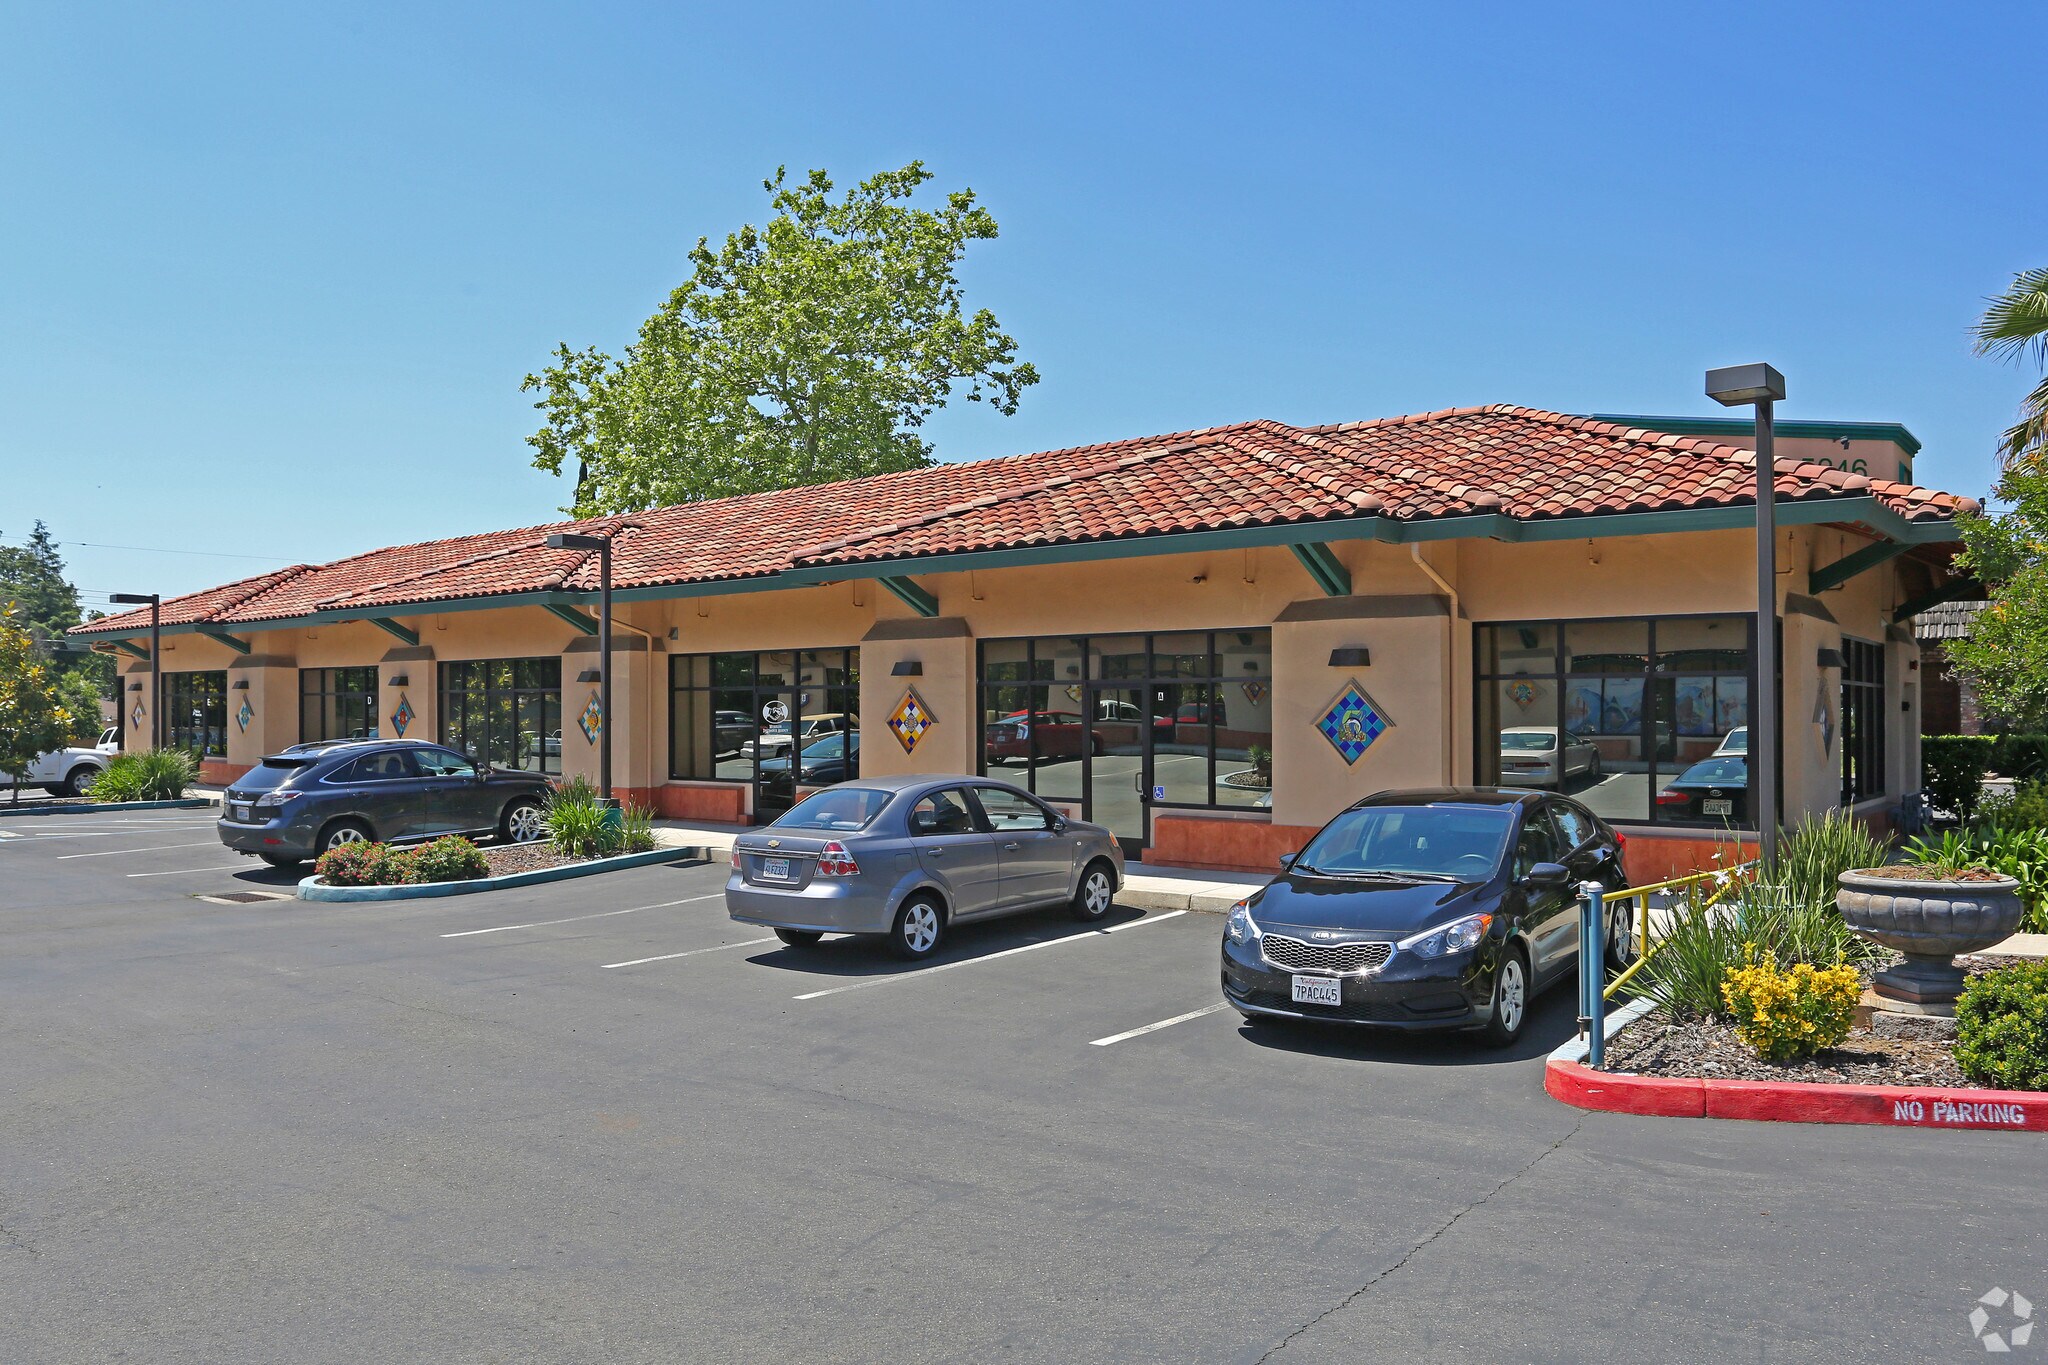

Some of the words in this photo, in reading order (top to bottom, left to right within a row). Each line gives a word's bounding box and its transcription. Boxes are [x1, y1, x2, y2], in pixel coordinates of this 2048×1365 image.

[1802, 458, 1867, 476] 46
[367, 696, 372, 705] D
[1295, 985, 1338, 1001] 7PAC445
[1894, 1101, 1924, 1121] NO
[1933, 1102, 2026, 1124] PARKING
